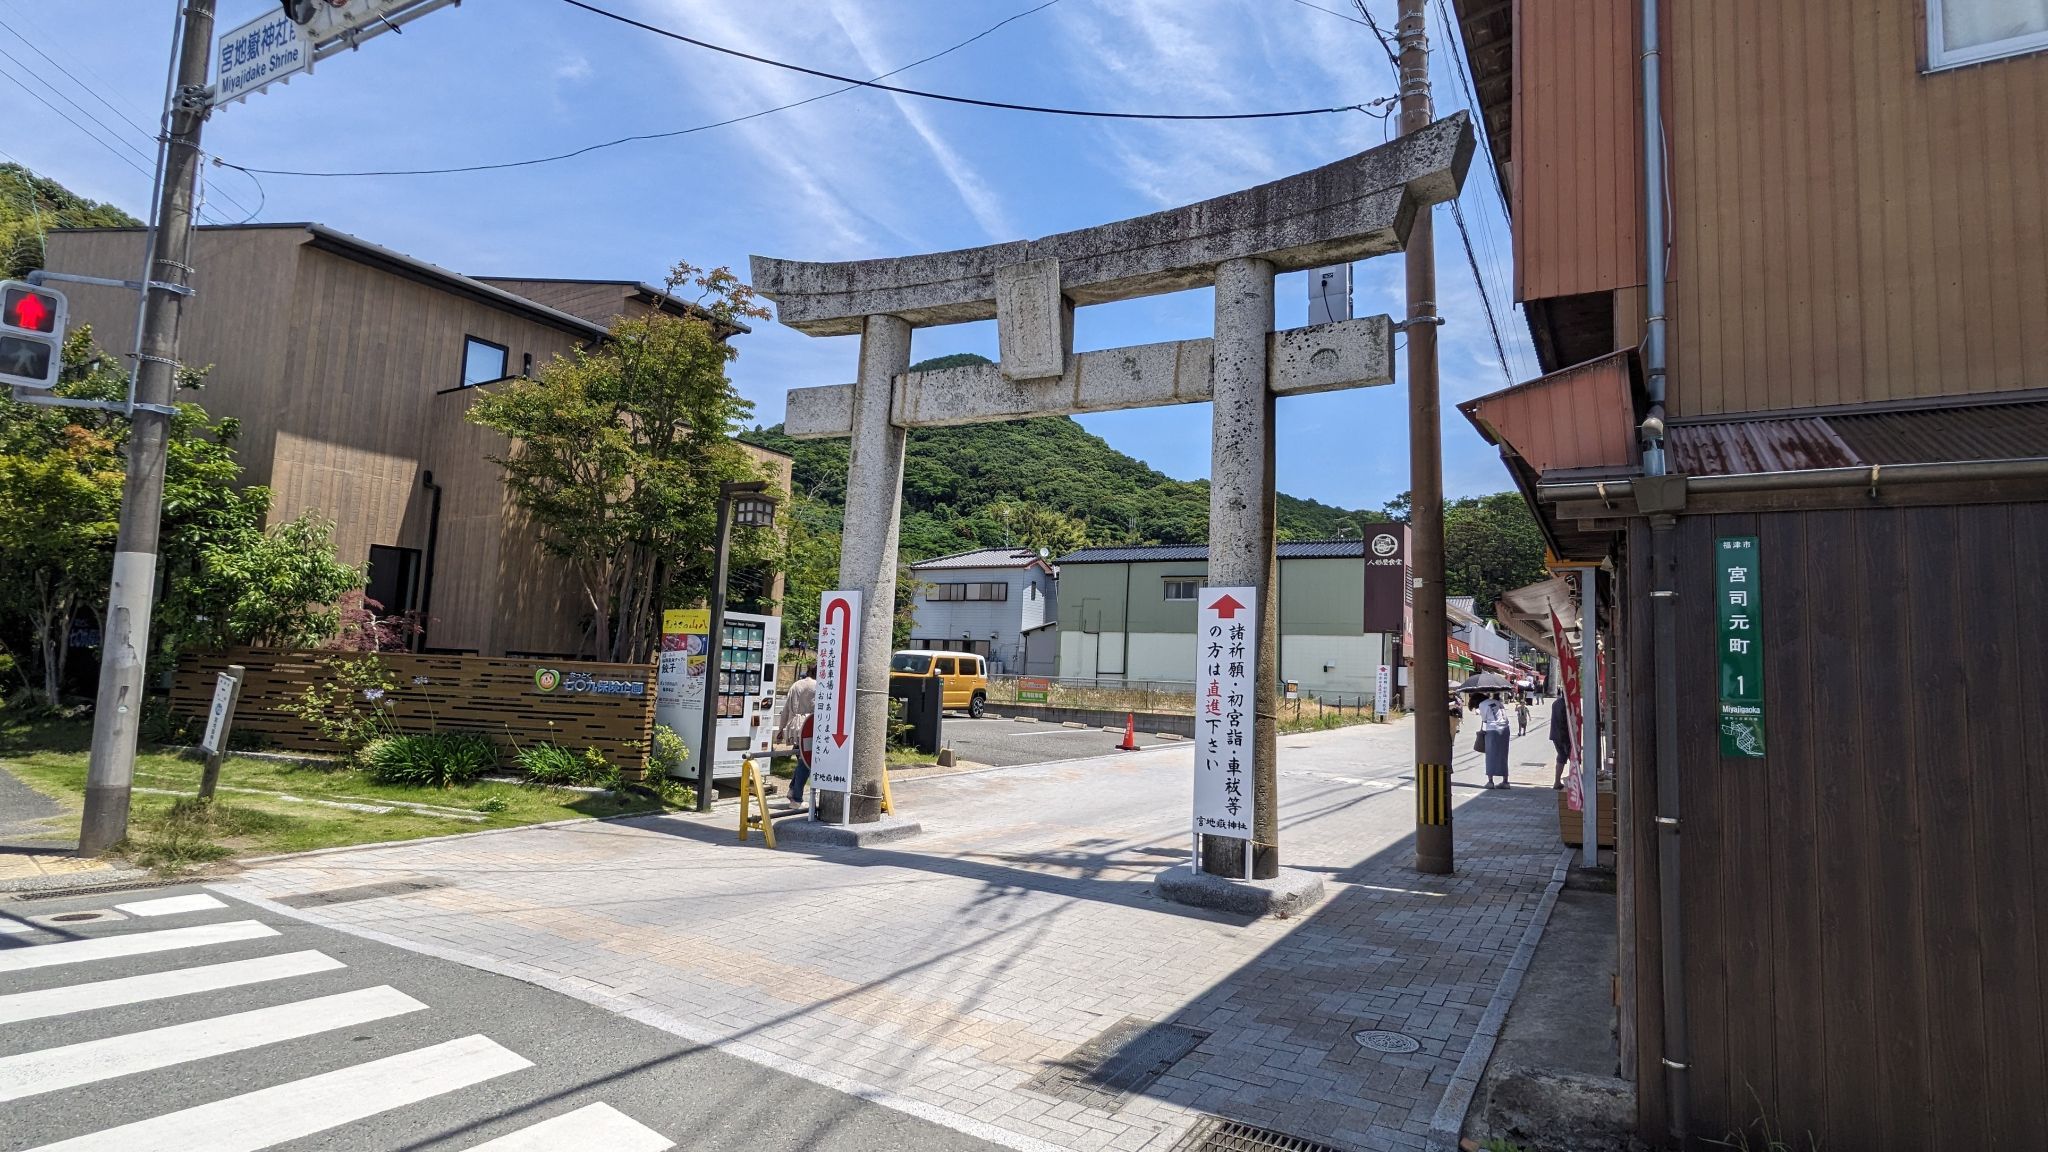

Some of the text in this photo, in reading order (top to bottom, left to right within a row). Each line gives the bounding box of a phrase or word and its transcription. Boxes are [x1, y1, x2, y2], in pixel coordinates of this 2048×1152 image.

[222, 48, 299, 94] Miyajidake Shrine
[1723, 541, 1751, 549] 福津市
[1728, 566, 1750, 654] 宮司元町
[815, 627, 829, 764] 第一駐車場へお回りください
[823, 628, 836, 754] この先駐車場はありません
[1205, 625, 1223, 771] の方は直進下さい
[1722, 705, 1760, 714] Miyajigaoka
[1737, 675, 1744, 695] 1
